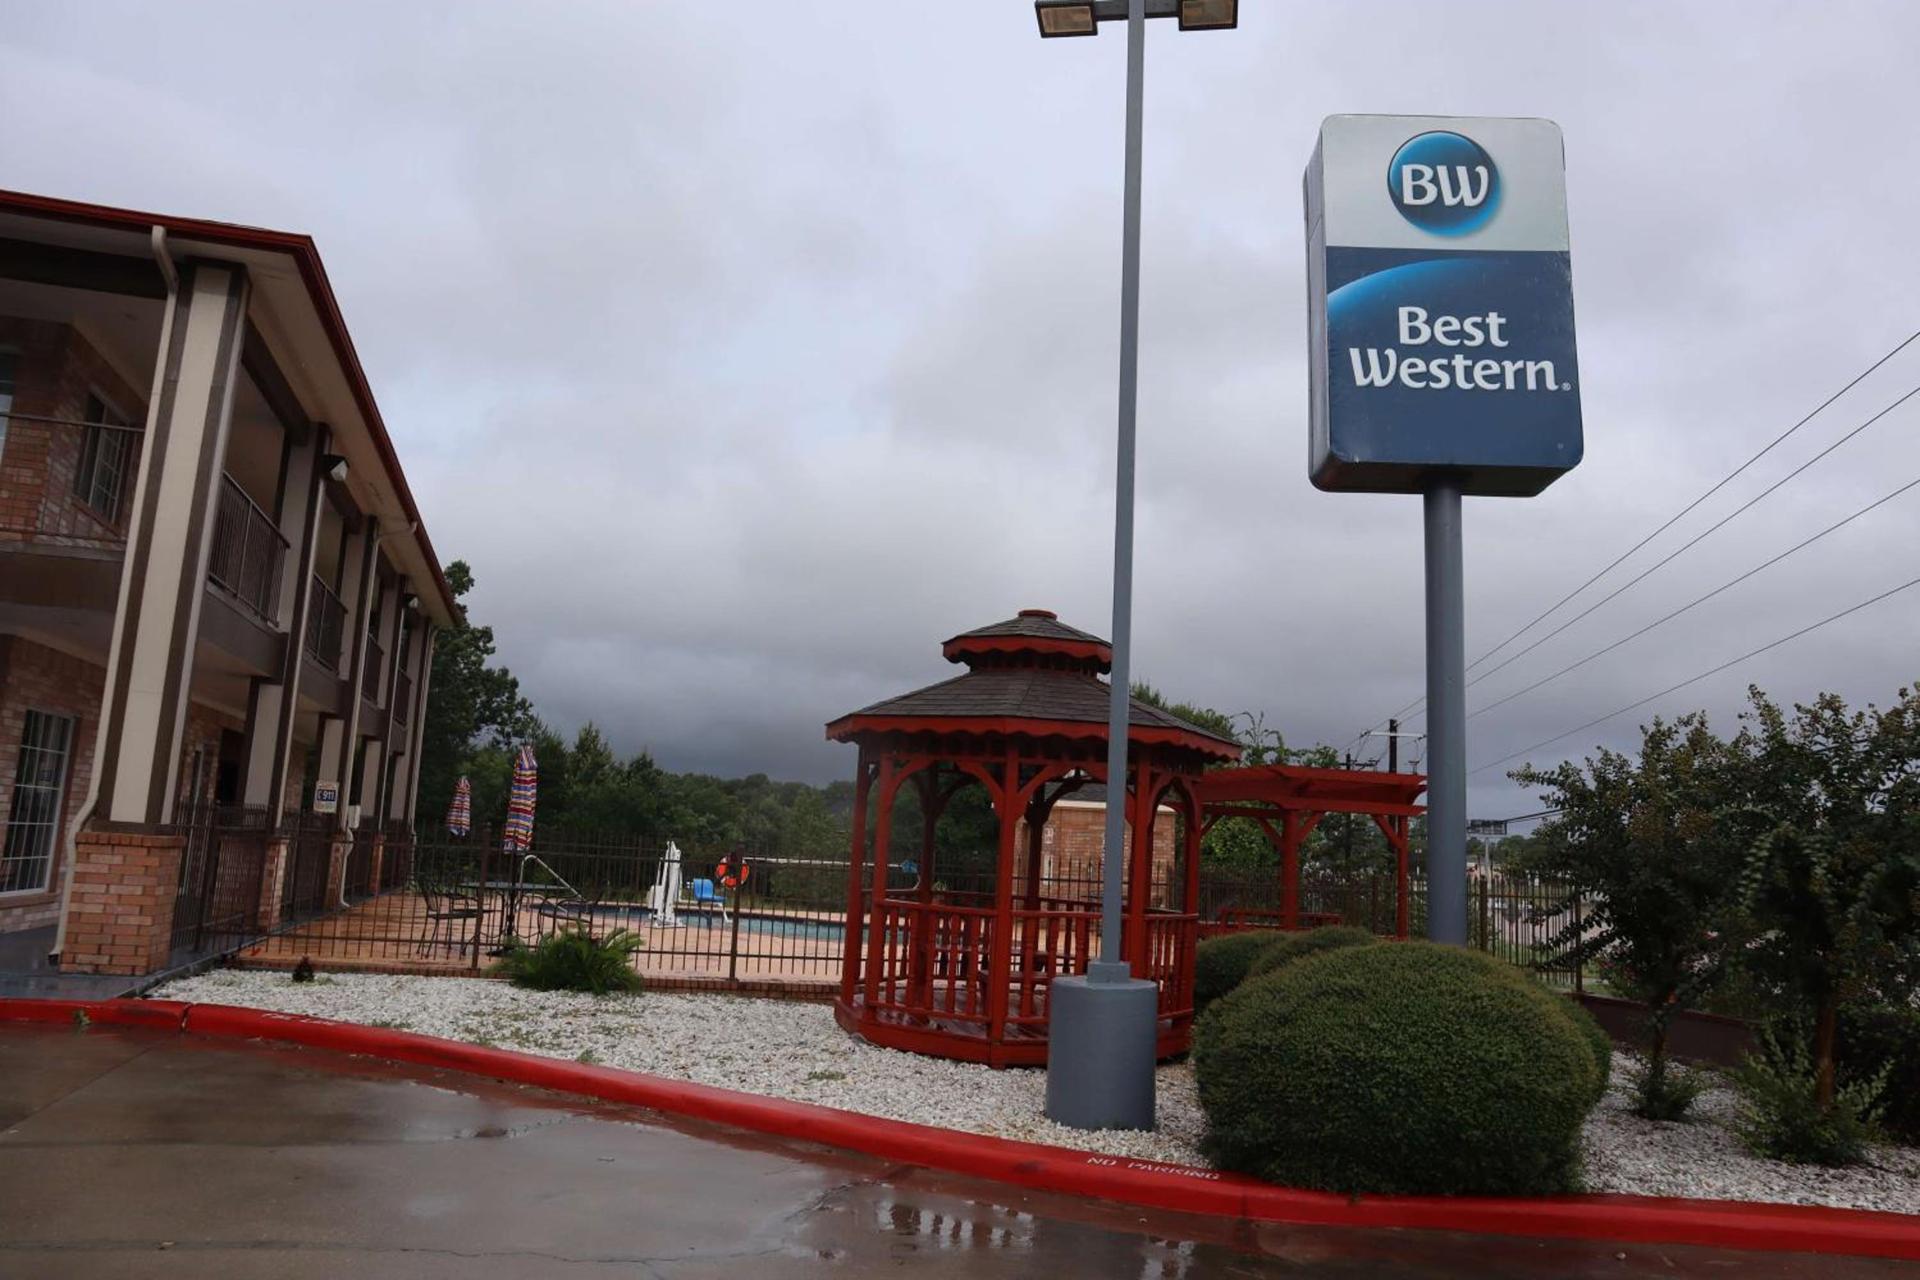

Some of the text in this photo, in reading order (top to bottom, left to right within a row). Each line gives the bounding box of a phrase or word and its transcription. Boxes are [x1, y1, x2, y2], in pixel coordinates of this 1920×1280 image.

[1402, 163, 1489, 207] BW
[1398, 306, 1509, 347] Best
[1087, 1157, 1220, 1180] NO PARKING
